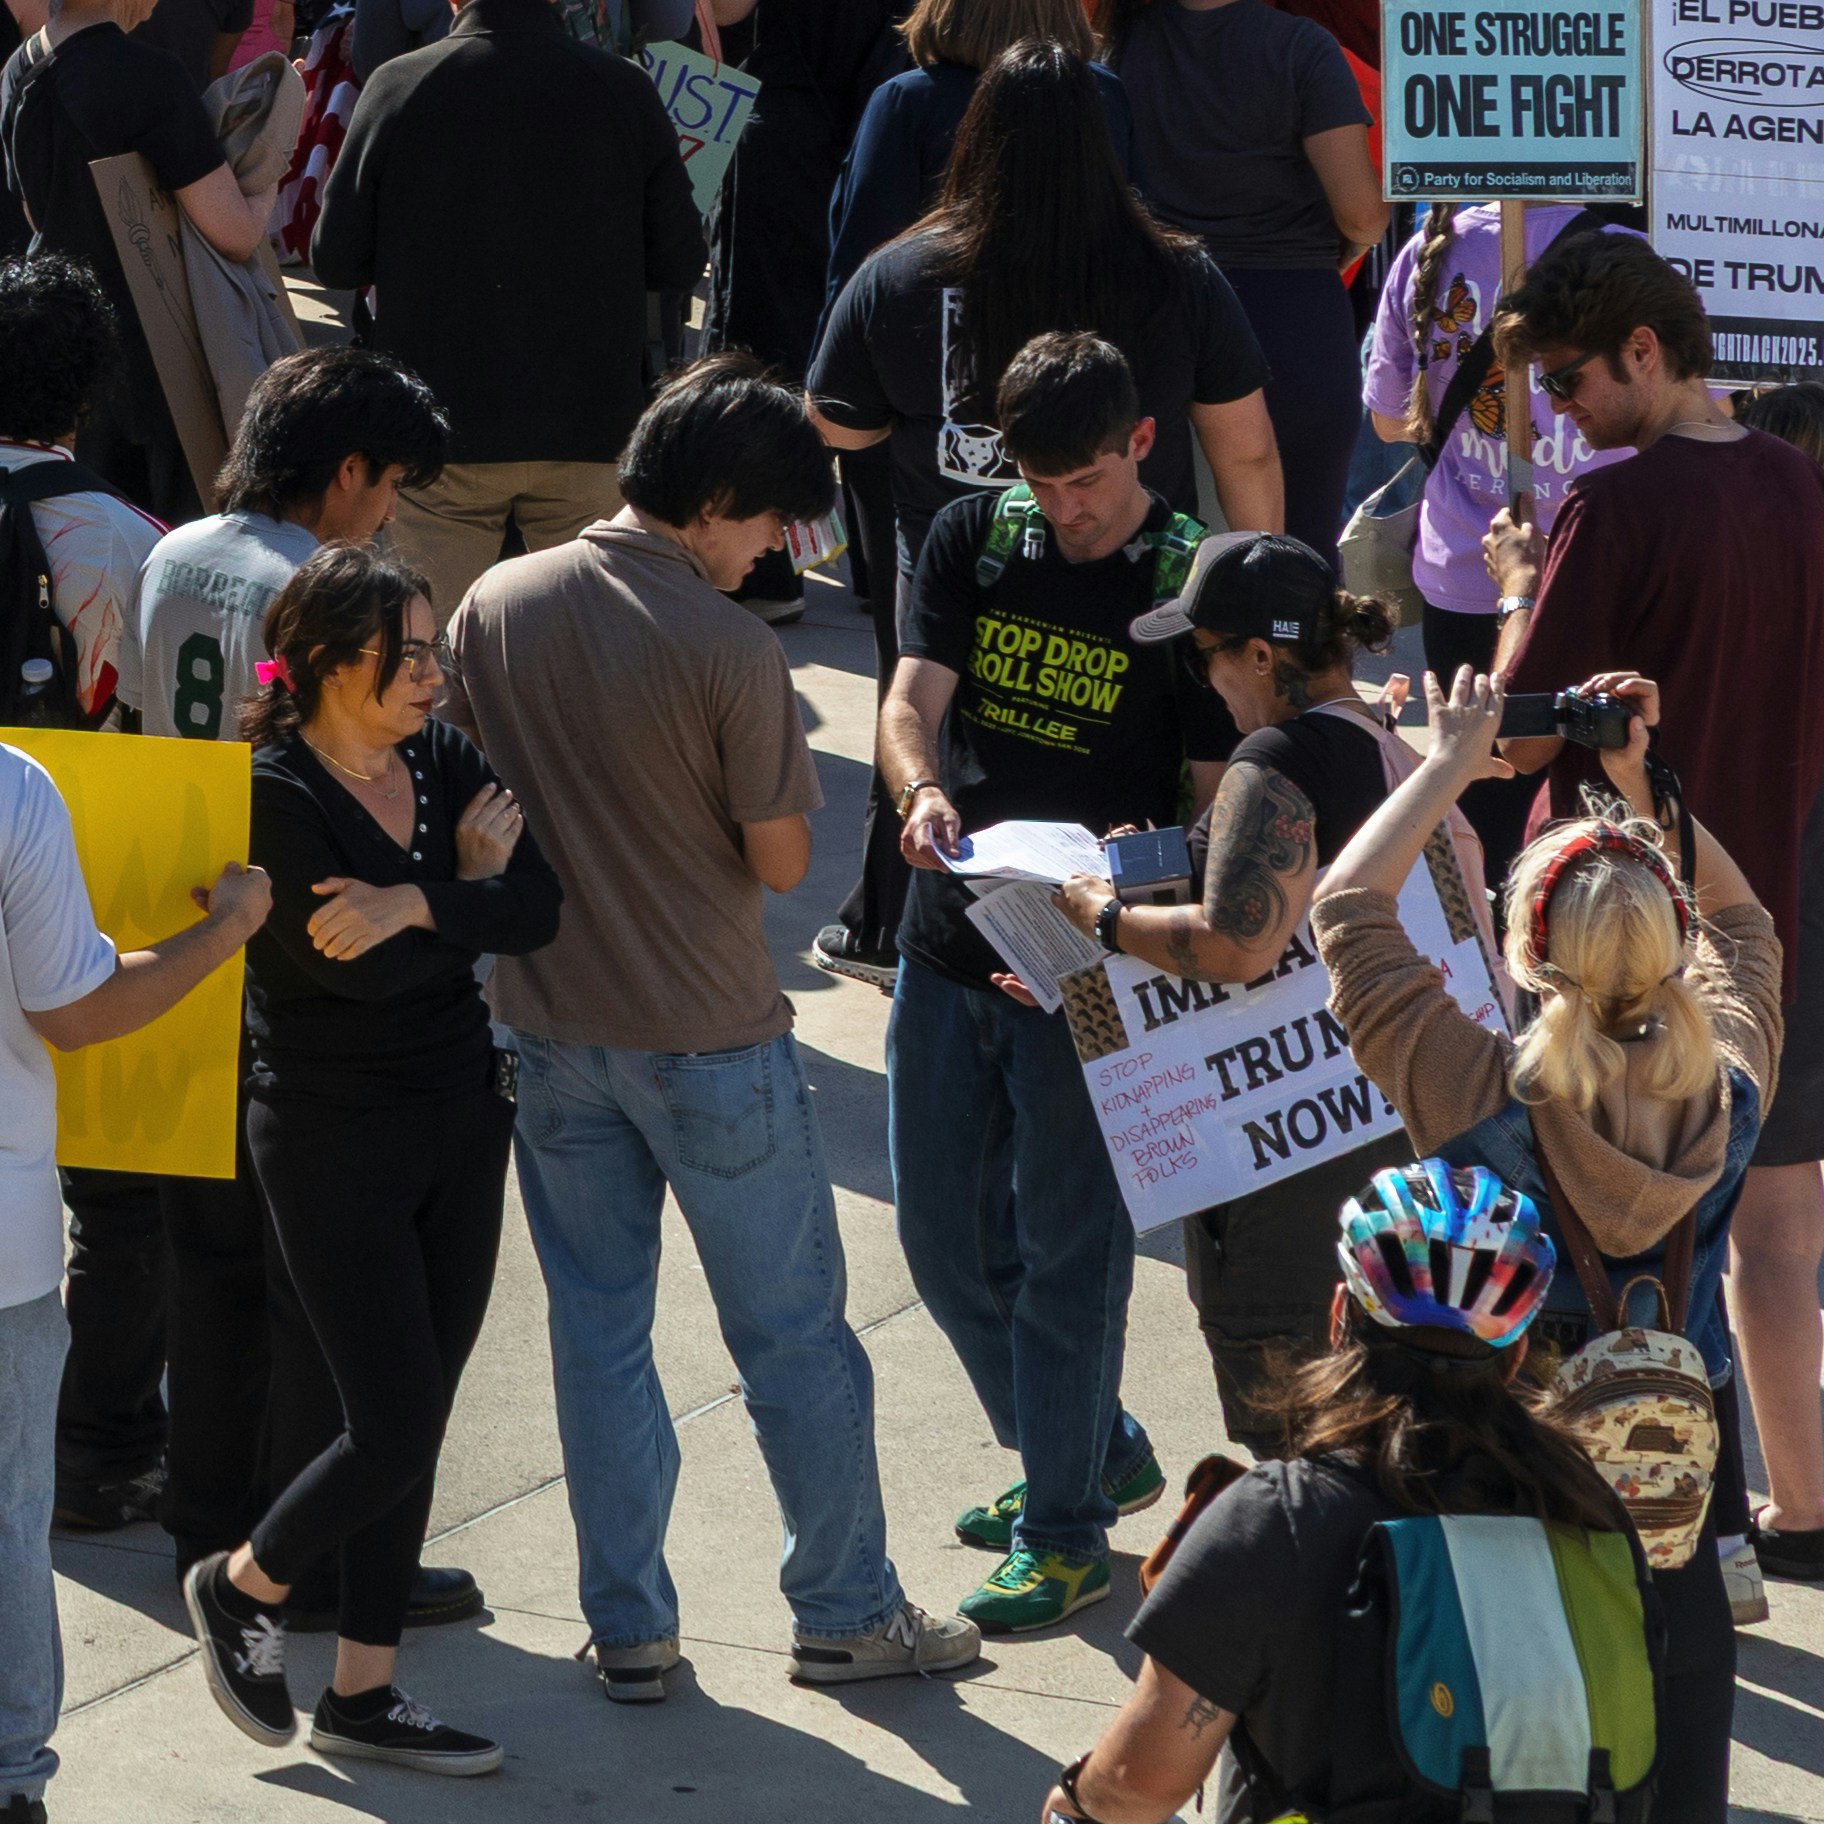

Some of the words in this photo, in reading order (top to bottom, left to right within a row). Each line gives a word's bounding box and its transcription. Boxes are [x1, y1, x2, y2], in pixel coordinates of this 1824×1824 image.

[1401, 12, 1466, 56] ONE
[1474, 12, 1625, 57] STRUGGLE
[1404, 76, 1499, 138] ONE
[1511, 76, 1625, 138] FIGHT
[1672, 110, 1718, 139] LA
[1424, 172, 1460, 188] Party
[1464, 171, 1483, 185] for
[1486, 171, 1545, 186] Socialism
[1548, 171, 1572, 186] and
[1575, 172, 1633, 188] Liberation
[975, 616, 1042, 660] STOP
[1042, 635, 1130, 681] DROP
[173, 631, 225, 740] 8
[968, 650, 1032, 692] ROLL
[1036, 667, 1124, 714] SHOW
[978, 698, 1035, 731] TRILL
[1034, 717, 1078, 741] LEE
[1100, 1052, 1152, 1086] STOP
[1101, 1063, 1195, 1117] KIDNAPPING
[1111, 1092, 1217, 1153] DISAPPEARING
[1131, 1132, 1195, 1167] BROWN
[1132, 1153, 1198, 1190] FOLKS
